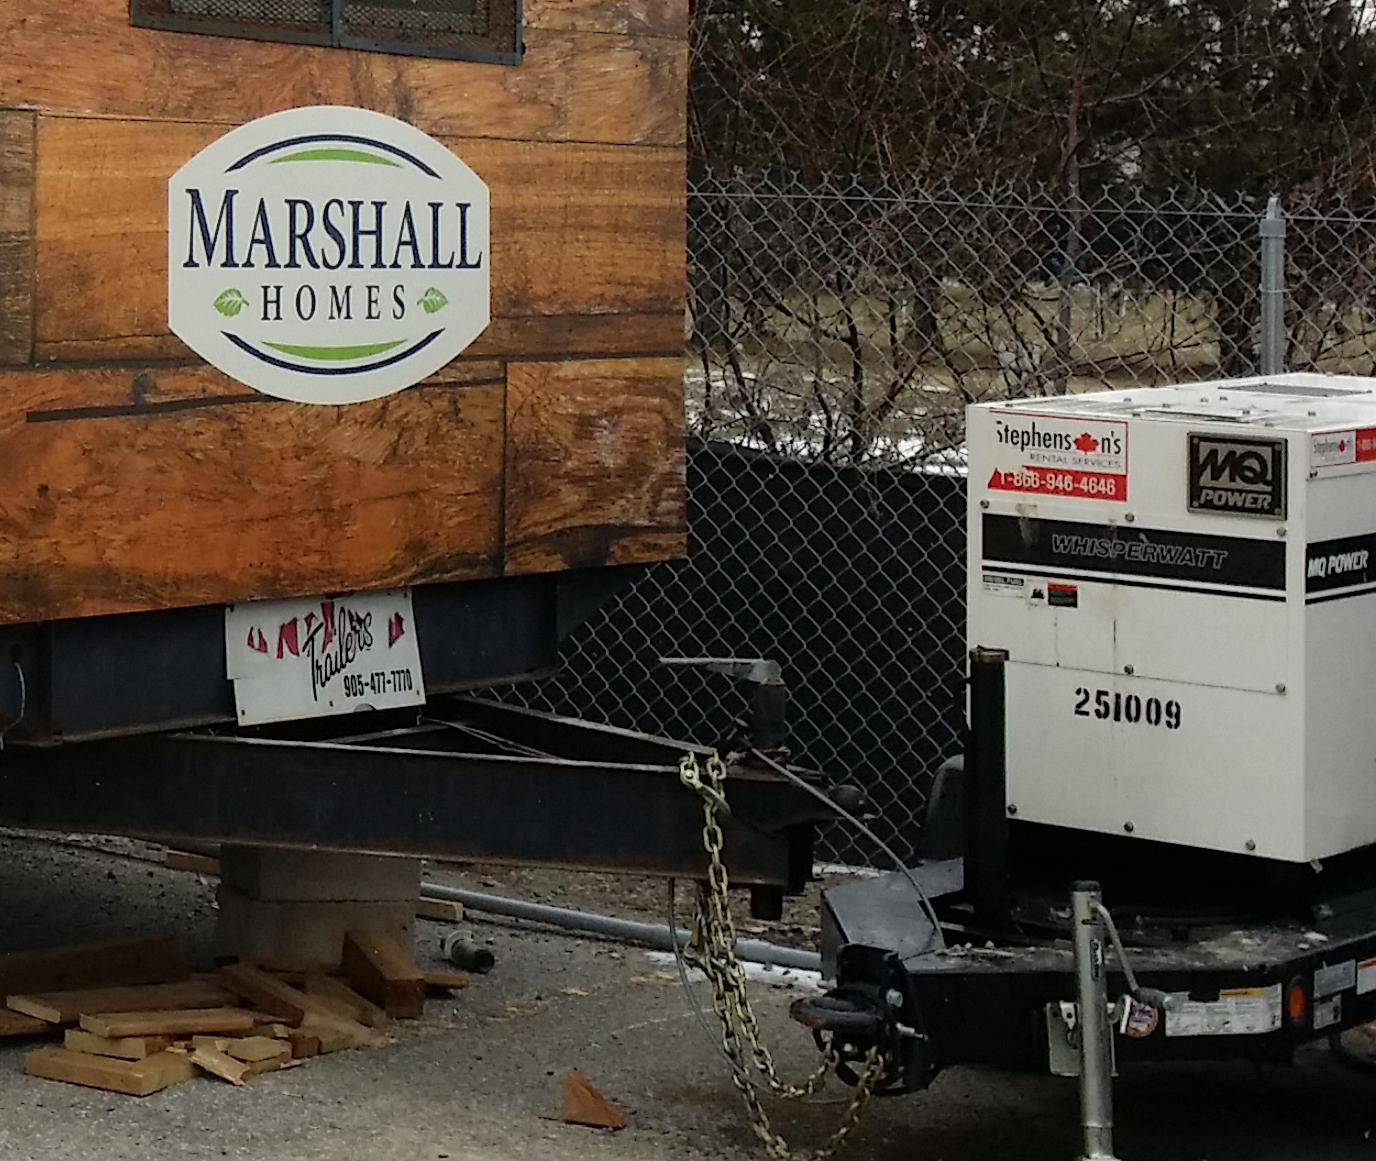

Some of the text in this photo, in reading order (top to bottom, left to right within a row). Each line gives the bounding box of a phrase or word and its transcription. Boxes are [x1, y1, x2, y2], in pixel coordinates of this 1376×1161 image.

[182, 188, 483, 270] MARSHALL
[260, 284, 406, 321] HOMES
[1029, 452, 1122, 469] RENTAL SERVICES
[1198, 448, 1273, 487] MQ
[999, 469, 1117, 496] 1-866-946-4646
[1200, 489, 1272, 510] POWER
[1052, 533, 1229, 569] WHISPERWATT
[1307, 550, 1369, 579] MQ POWER
[302, 606, 374, 702] Trailers
[343, 668, 414, 698] 905-477-7770
[1074, 687, 1181, 730] 251009
